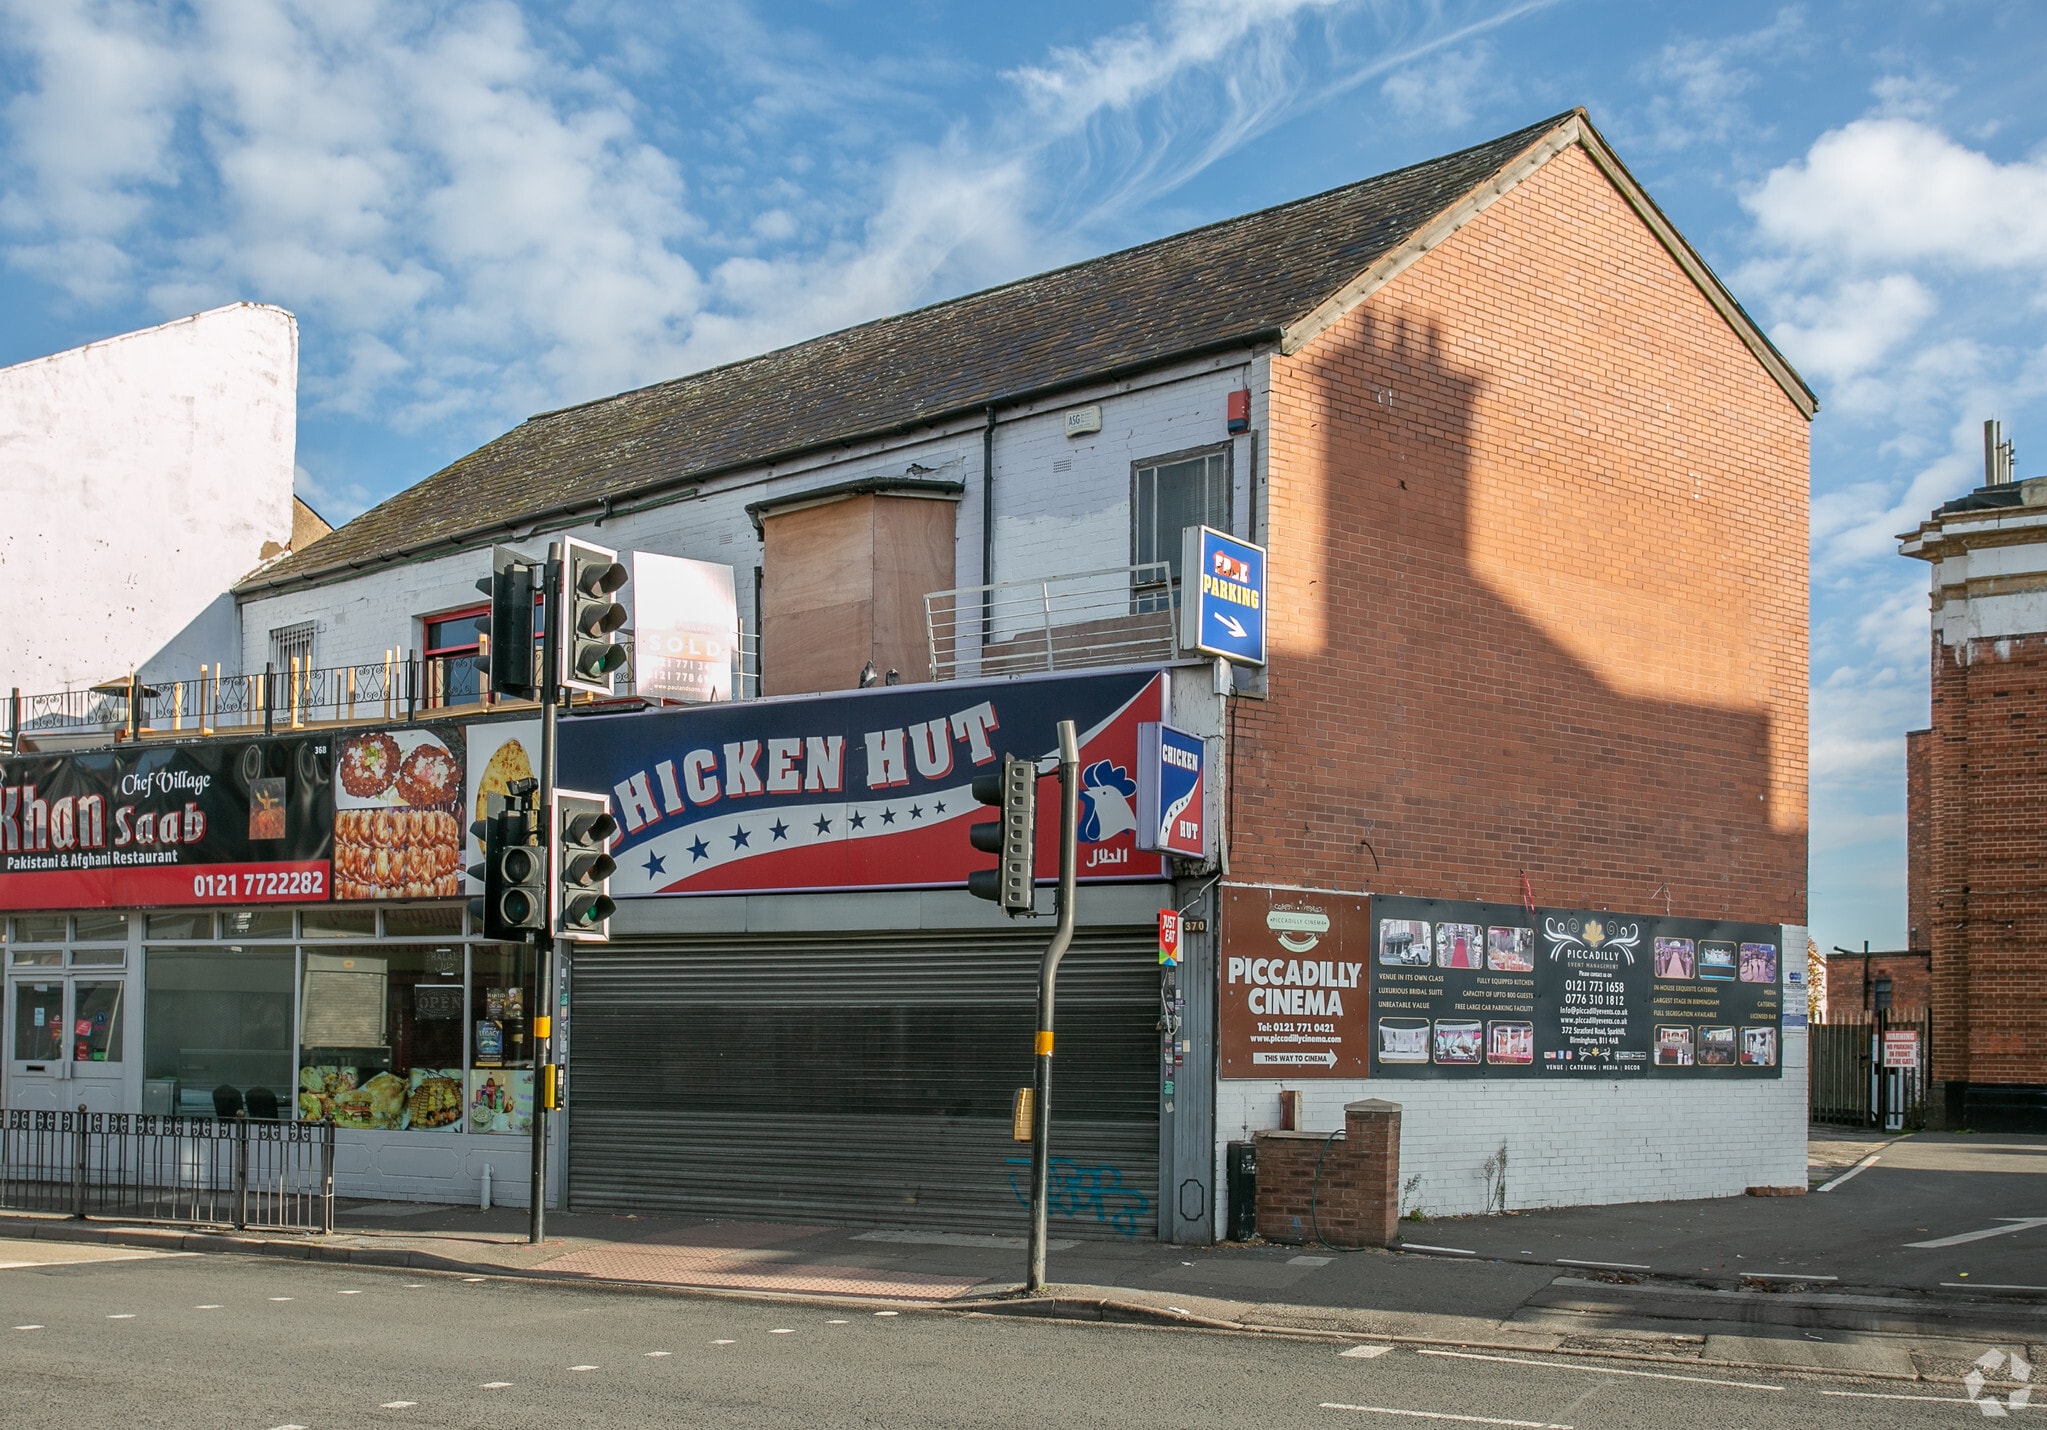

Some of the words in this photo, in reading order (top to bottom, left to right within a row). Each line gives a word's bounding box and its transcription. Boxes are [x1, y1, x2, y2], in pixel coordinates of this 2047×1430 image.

[1068, 414, 1081, 426] ASG
[1215, 554, 1248, 584] FRE
[1203, 574, 1260, 610] PARKING
[648, 634, 721, 657] SOLD
[676, 672, 694, 683] 778
[314, 745, 327, 755] 368
[1162, 743, 1199, 772] CHICKEN
[610, 735, 845, 849] HICKEN
[864, 701, 999, 790] HUT
[121, 772, 154, 799] Chef
[156, 770, 211, 796] Village
[0, 784, 106, 853] Khan
[115, 802, 207, 846] Saab
[1180, 820, 1198, 840] HUT
[7, 854, 58, 870] Pakistani
[60, 855, 69, 868] &
[70, 851, 111, 870] Afghani
[113, 849, 178, 865] Restaurant
[1086, 847, 1128, 868] الحلال
[193, 874, 237, 898] 0121
[243, 870, 323, 896] 7722282
[1162, 914, 1176, 929] JUST
[1185, 921, 1204, 932] 370
[1272, 917, 1303, 925] PICCADILLY
[1164, 930, 1175, 943] EAT
[431, 952, 457, 961] HALAL
[1567, 949, 1619, 961] PICCADILLY
[1228, 957, 1362, 988] PICCADILLY
[1586, 962, 1619, 970] MANAGEMENT
[1491, 977, 1513, 985] EQUIPPED
[1514, 978, 1534, 986] KITCHEN
[1565, 980, 1586, 991] 0121
[1589, 981, 1603, 992] 773
[1606, 981, 1624, 993] 1658
[1429, 988, 1443, 996] SUITE
[1462, 990, 1485, 998] CAPACITY
[420, 996, 460, 1009] OPEN
[1248, 987, 1344, 1017] CINEMA
[1565, 993, 1587, 1004] 0776
[1589, 995, 1604, 1005] 310
[1606, 995, 1624, 1006] 1812
[1492, 1004, 1513, 1012] PARKING
[1257, 1022, 1273, 1032] Tel:
[1273, 1022, 1294, 1032] 0121
[1296, 1023, 1312, 1032] 771
[1313, 1023, 1335, 1033] 0421
[1562, 1026, 1572, 1034] 372
[1250, 1034, 1342, 1044] www.piccadillycinema.com
